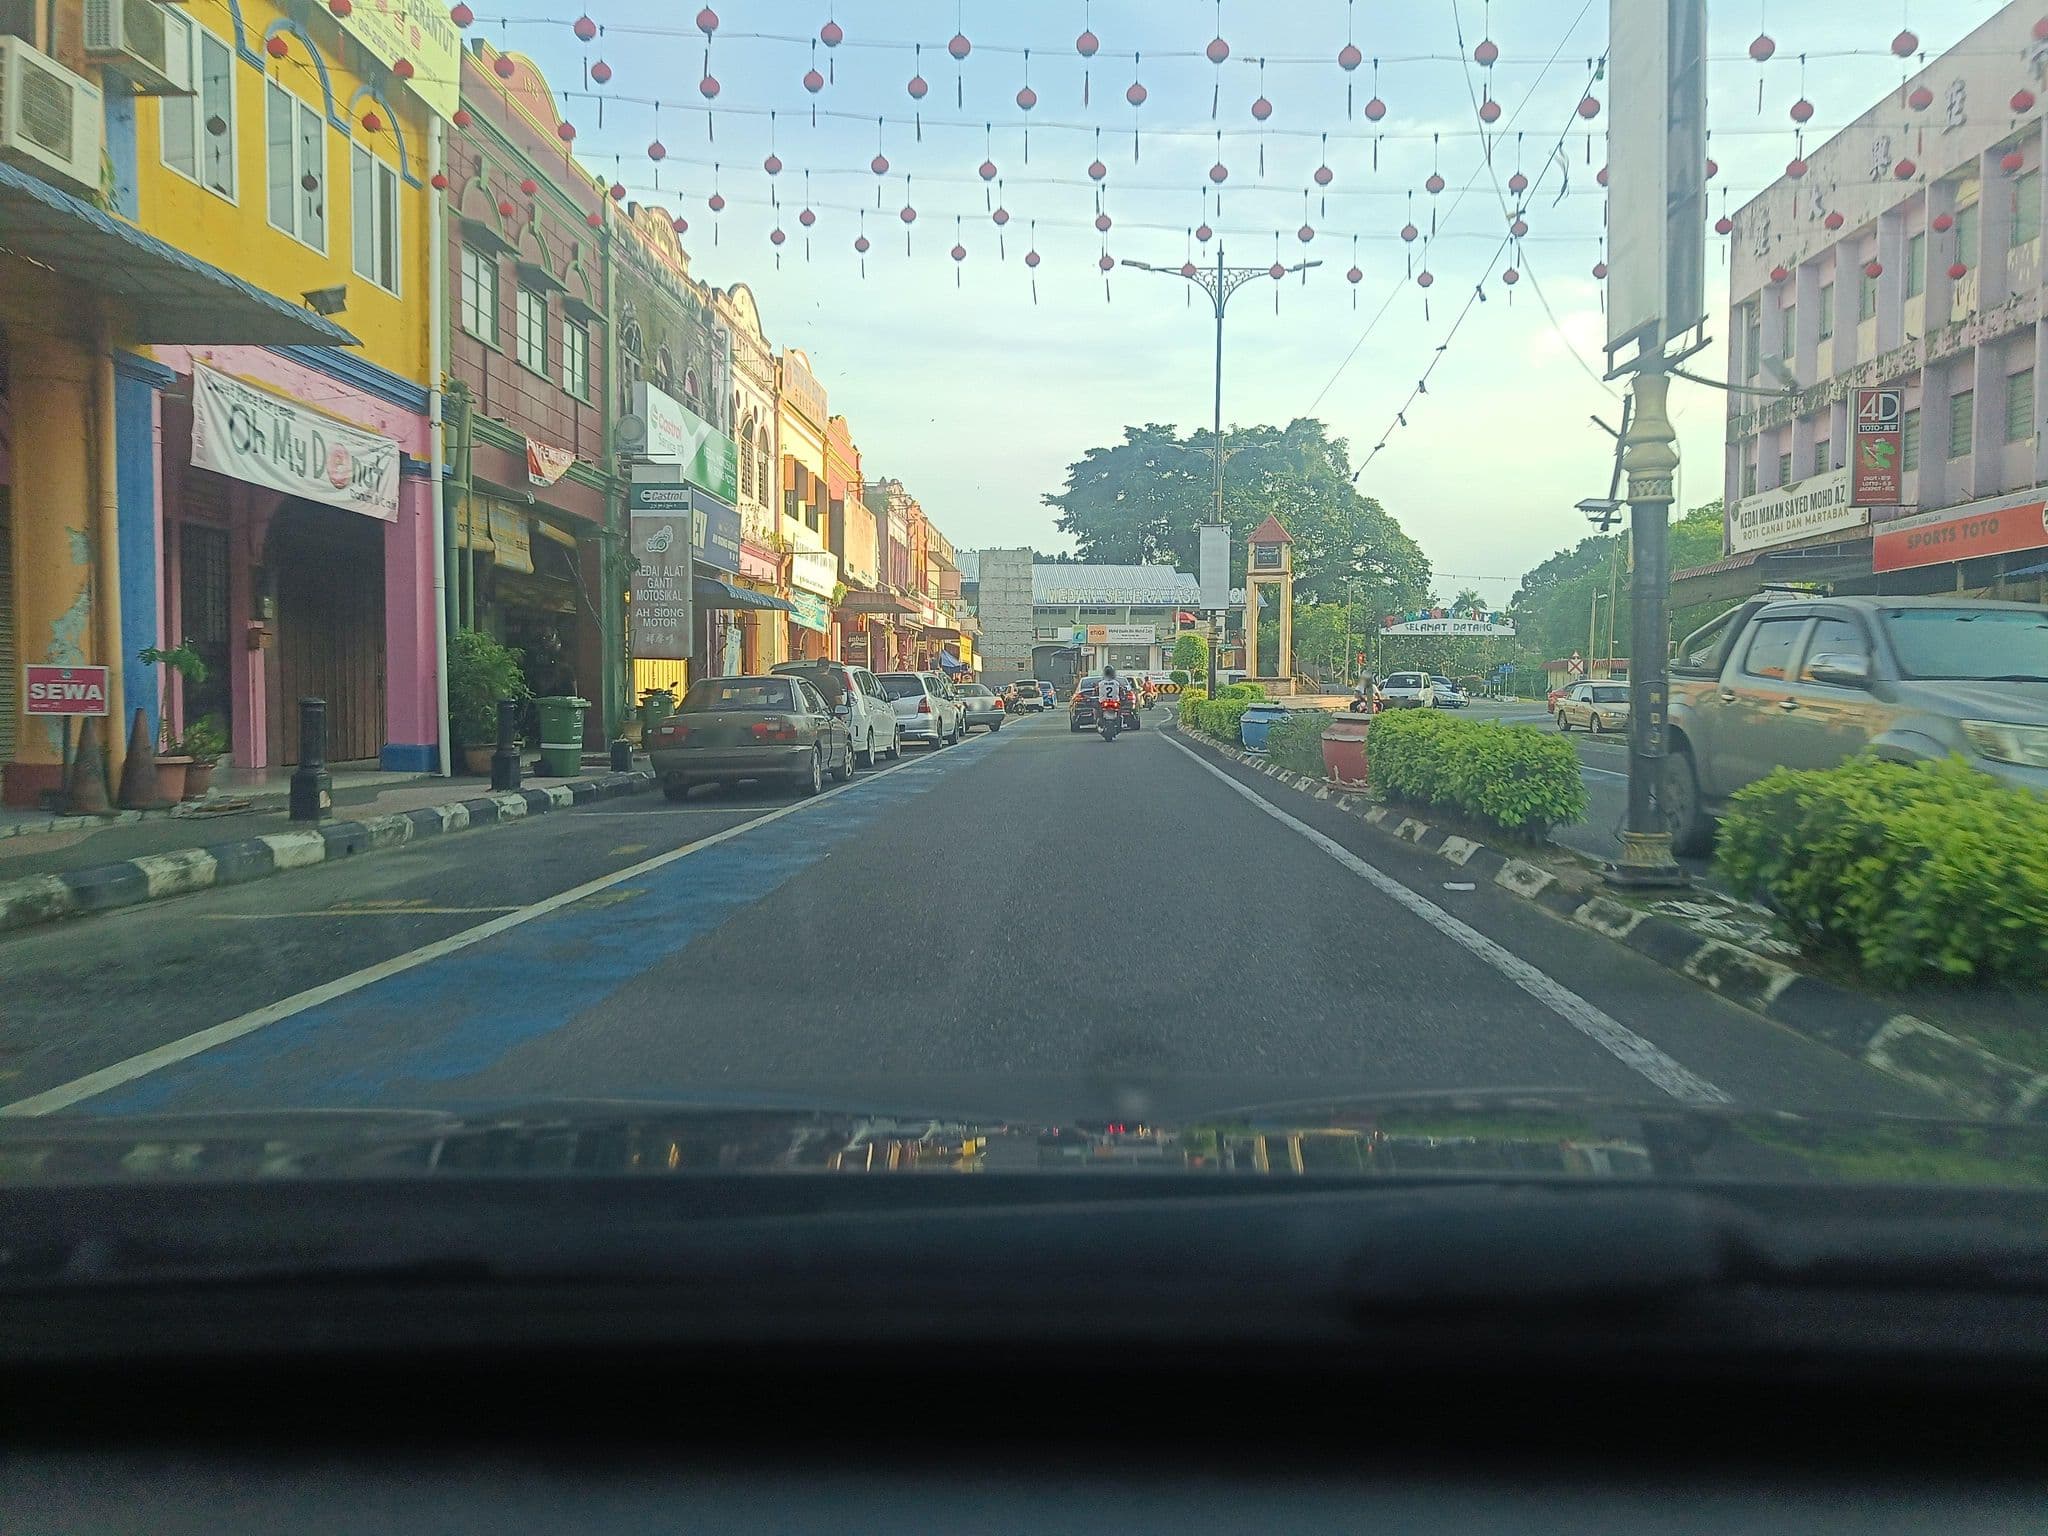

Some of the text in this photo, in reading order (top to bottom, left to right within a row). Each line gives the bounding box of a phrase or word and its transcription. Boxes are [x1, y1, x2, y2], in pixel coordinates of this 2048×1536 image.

[1859, 392, 1898, 421] 4D
[658, 412, 683, 440] Castrol
[229, 404, 265, 455] Oh
[273, 418, 306, 478] My
[651, 490, 684, 501] Castrol
[1740, 508, 1758, 530] KEDAI
[1759, 501, 1784, 526] MAKAN
[1785, 495, 1808, 518] SAYED
[1810, 488, 1833, 511] MOHD
[1835, 484, 1846, 503] AZ
[1743, 529, 1759, 541] ROTI
[1761, 524, 1784, 537] CANAI
[1786, 519, 1802, 530] DAN
[1804, 507, 1849, 526] MARTABAK
[1907, 519, 1999, 549] SPORTS TOTO
[636, 565, 685, 577] KEDAI ALAT
[647, 577, 673, 589] GANTI
[636, 589, 683, 601] MOTOSIKAL
[1046, 588, 1100, 604] MEDAN
[1106, 587, 1161, 604] SELERA
[635, 608, 684, 618] AH SIONG
[642, 617, 678, 628] MOTOR
[1404, 623, 1493, 632] SELAMAT DATANG
[30, 682, 105, 700] SEWA
[1105, 686, 1113, 698] 2
